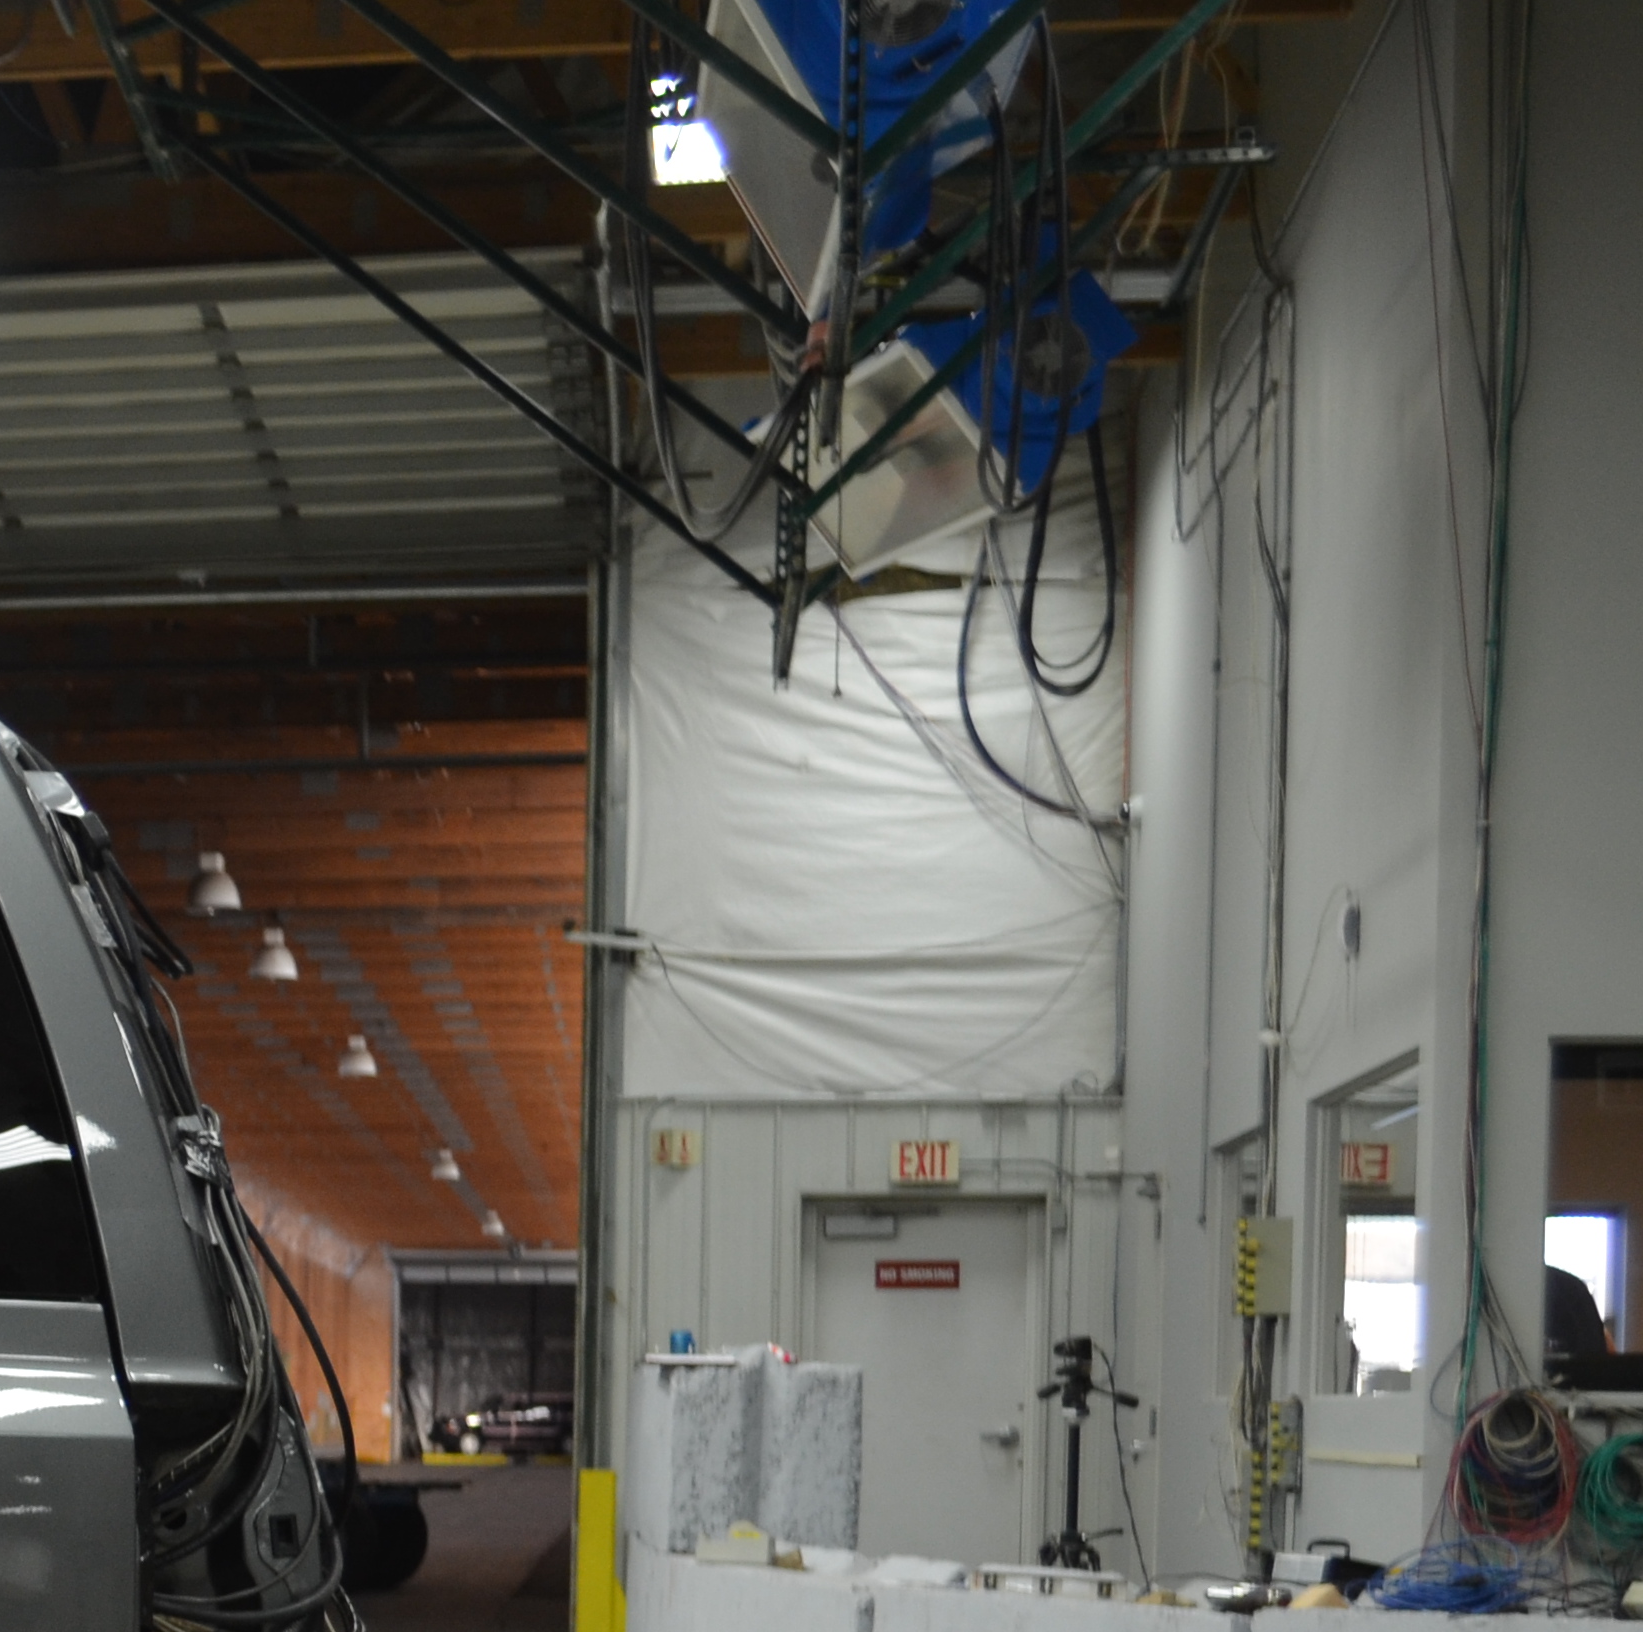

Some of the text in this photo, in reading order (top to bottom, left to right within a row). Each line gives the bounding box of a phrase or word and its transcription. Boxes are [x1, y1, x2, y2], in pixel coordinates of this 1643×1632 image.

[899, 1141, 950, 1178] EXIT
[879, 1267, 955, 1281] NO SMOKING
